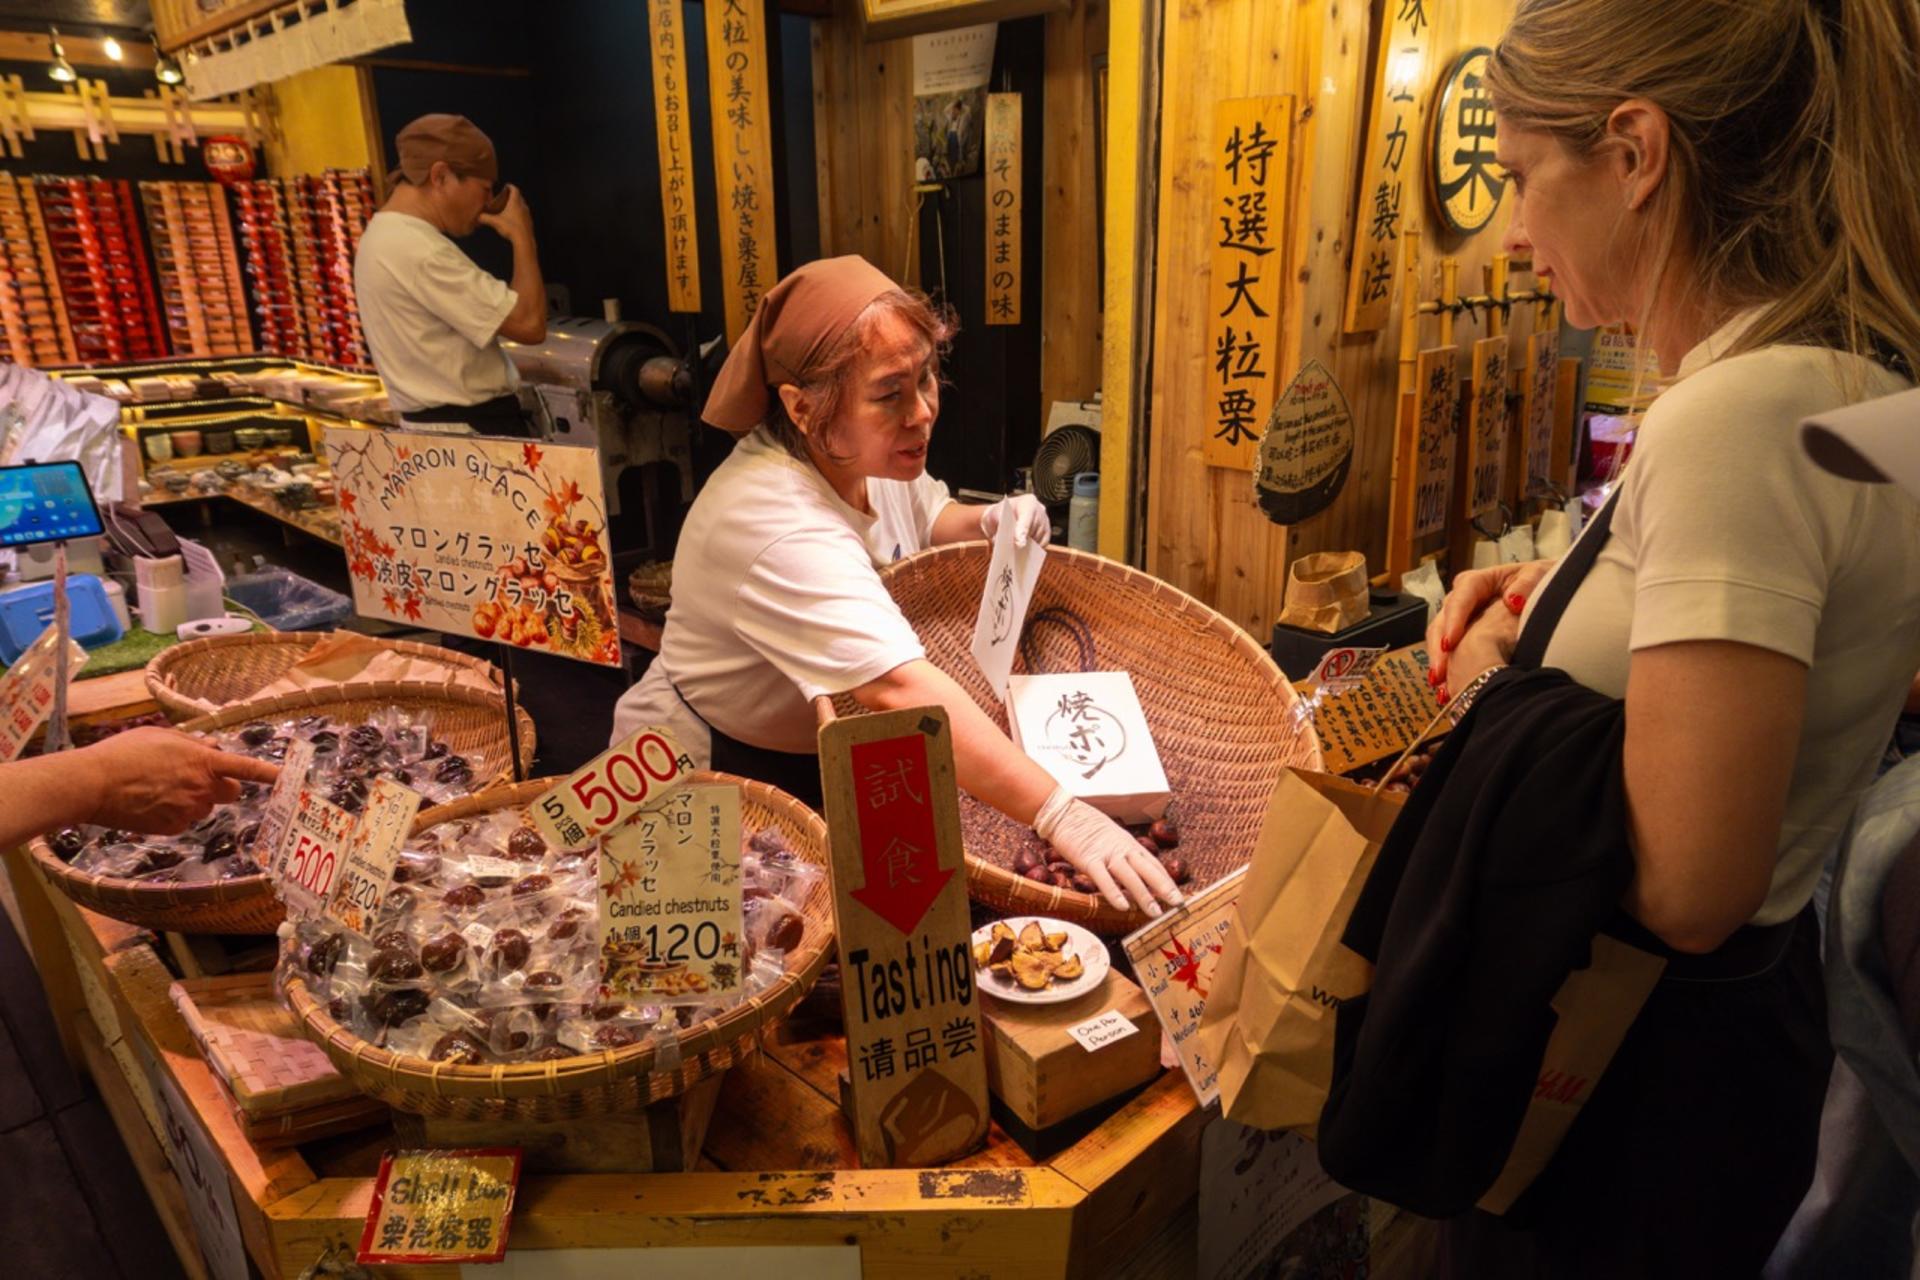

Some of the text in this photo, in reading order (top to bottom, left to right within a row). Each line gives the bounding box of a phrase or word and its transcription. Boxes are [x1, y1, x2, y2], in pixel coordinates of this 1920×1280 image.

[1213, 120, 1279, 447] 特選大粒栗
[379, 448, 456, 511] MARRON
[388, 525, 545, 569] マロングラッセ
[373, 556, 575, 616] 渋皮マロングラッセ
[1056, 690, 1105, 780] 焼ポン
[570, 733, 696, 826] 500 円
[542, 795, 565, 819] 5
[562, 820, 586, 847] 個
[676, 792, 694, 846] マロン
[863, 757, 924, 890] 試食
[292, 836, 337, 898] 500
[640, 821, 660, 893] グラッセ
[350, 874, 378, 911] 120
[609, 897, 730, 918] Candied chestnuts
[645, 921, 721, 963] 120
[848, 935, 973, 1024] Tasting
[858, 1015, 977, 1083] 请品尝
